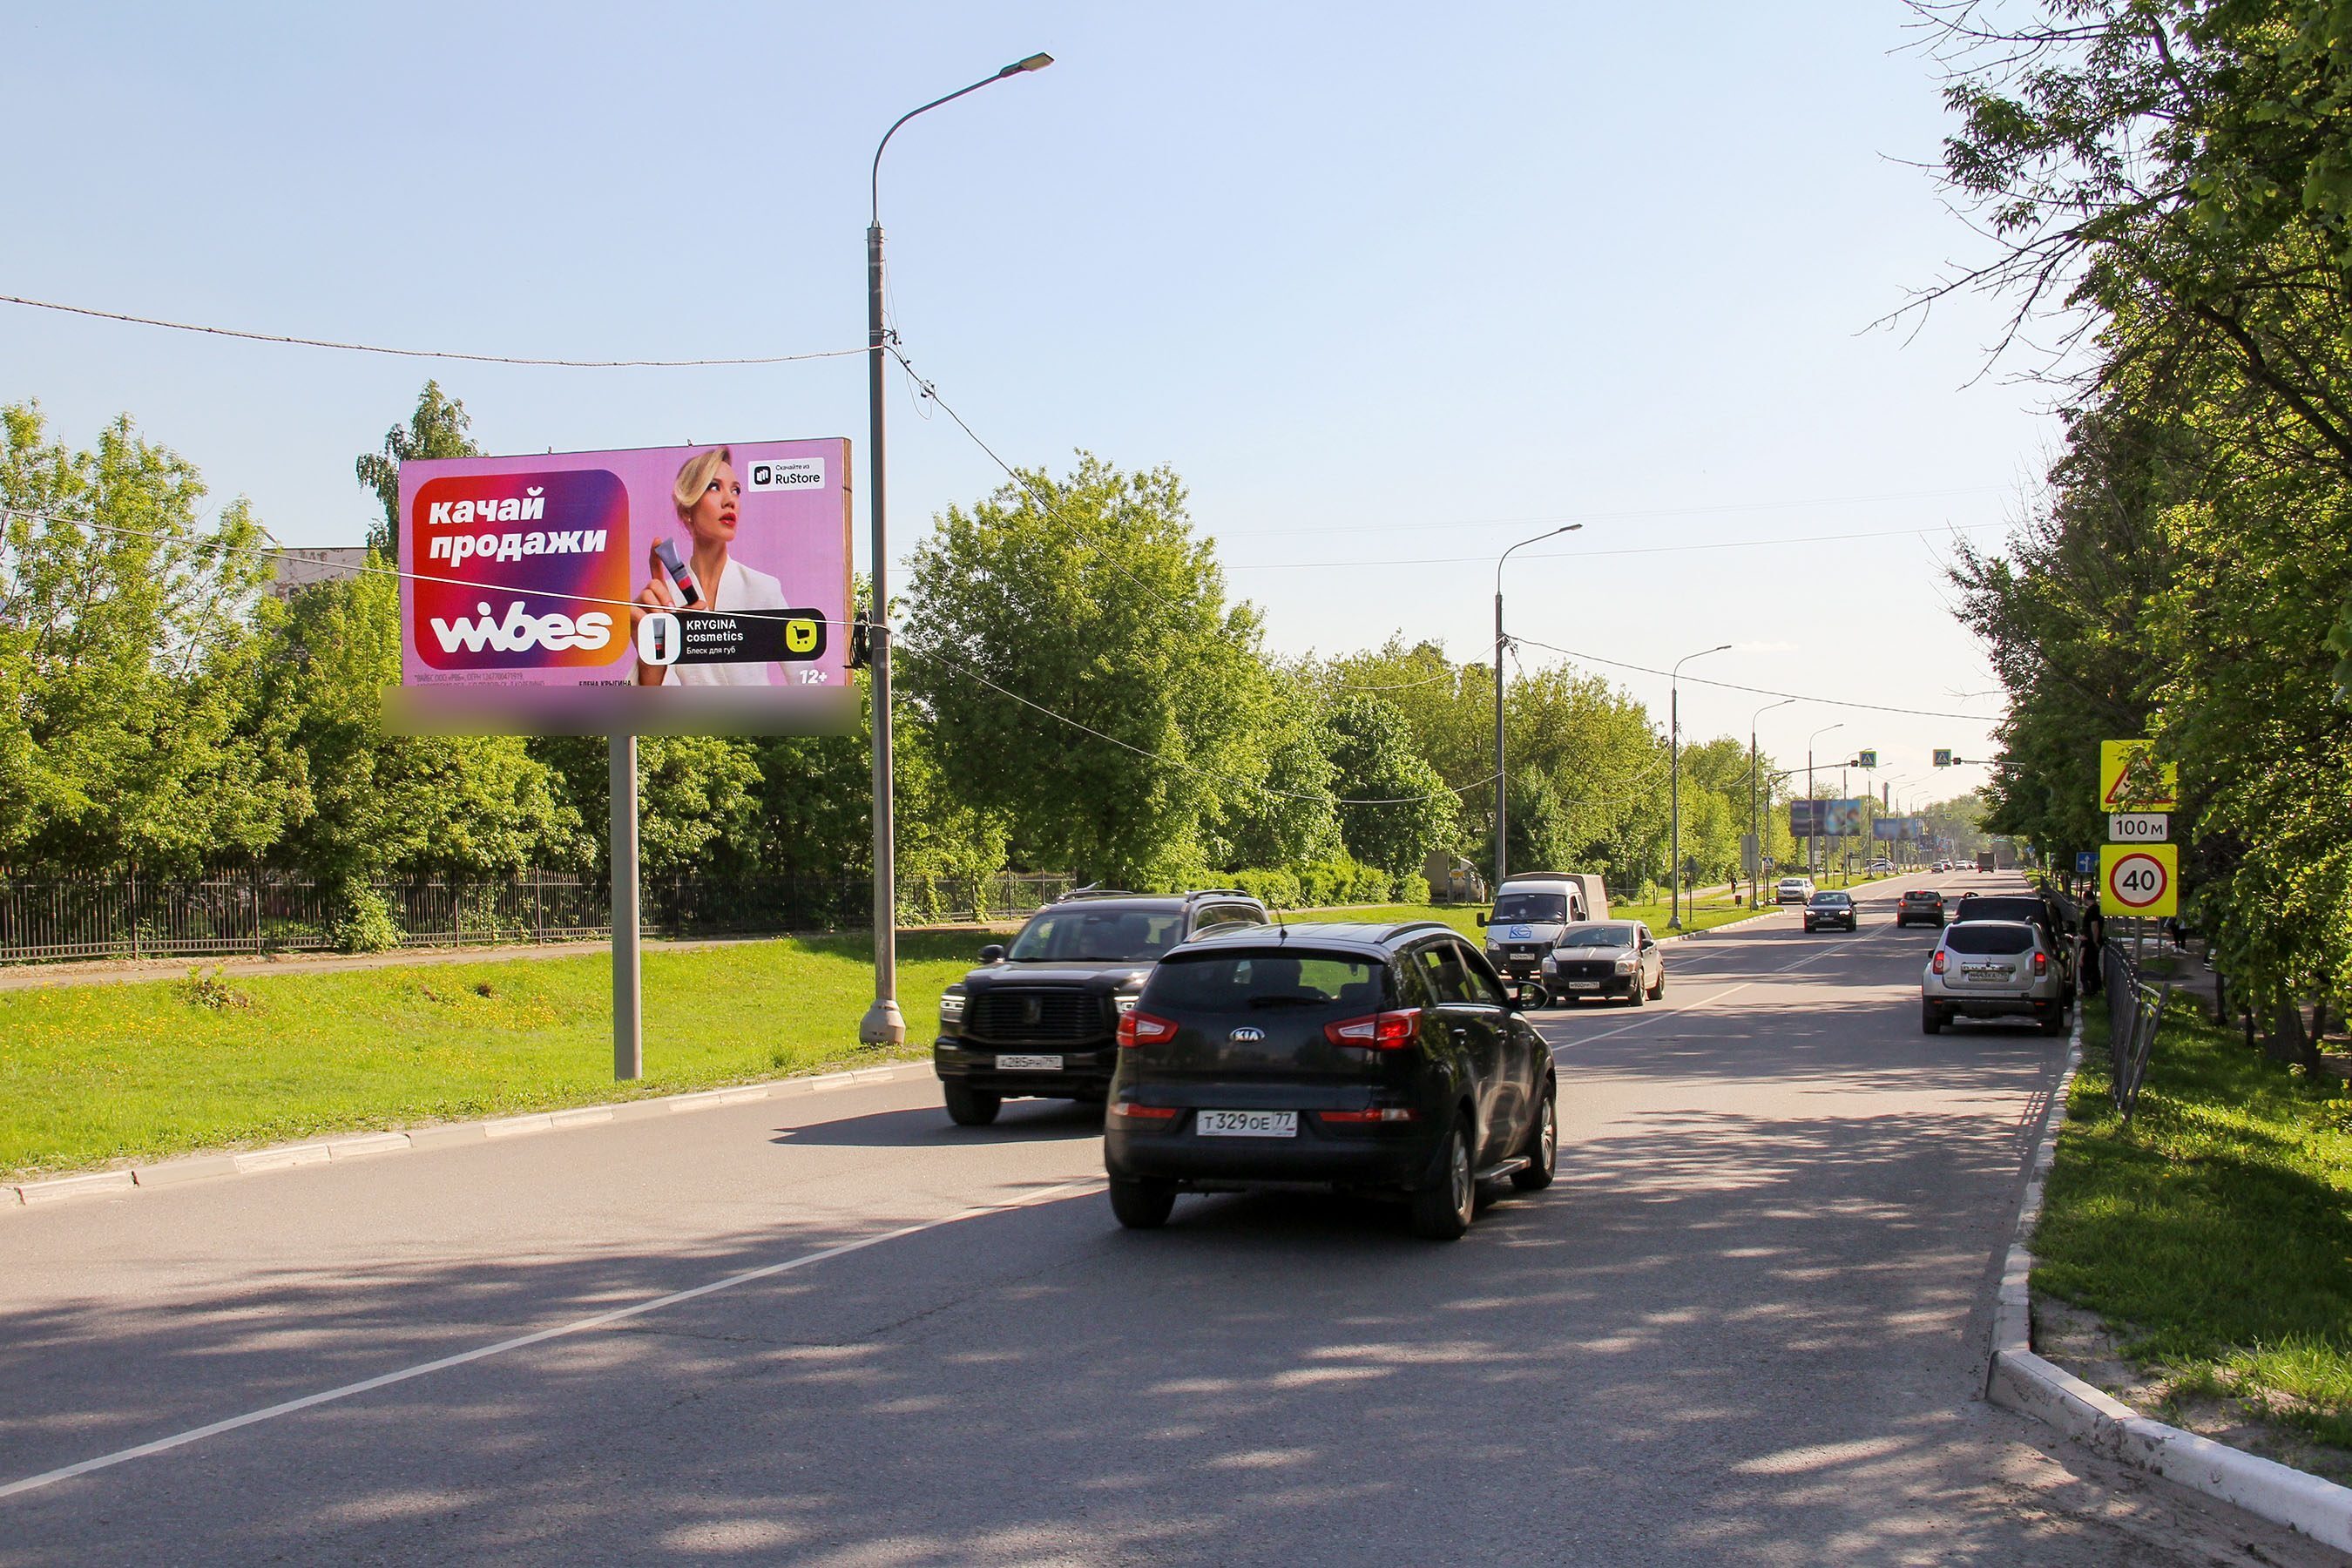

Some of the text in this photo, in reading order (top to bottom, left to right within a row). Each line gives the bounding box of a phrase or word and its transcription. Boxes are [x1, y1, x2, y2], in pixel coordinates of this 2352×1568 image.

[775, 473, 821, 484] RuStore
[429, 486, 545, 524] качай
[429, 530, 607, 567] продажи
[429, 601, 613, 652] wibes
[686, 619, 737, 631] KRYGINA
[686, 631, 744, 642] cosmetics
[686, 646, 708, 655] Блеск
[723, 645, 736, 654] губ
[799, 669, 828, 685] 12+
[2116, 820, 2148, 835] 100
[2121, 869, 2155, 891] 40
[1235, 1031, 1260, 1041] KIA
